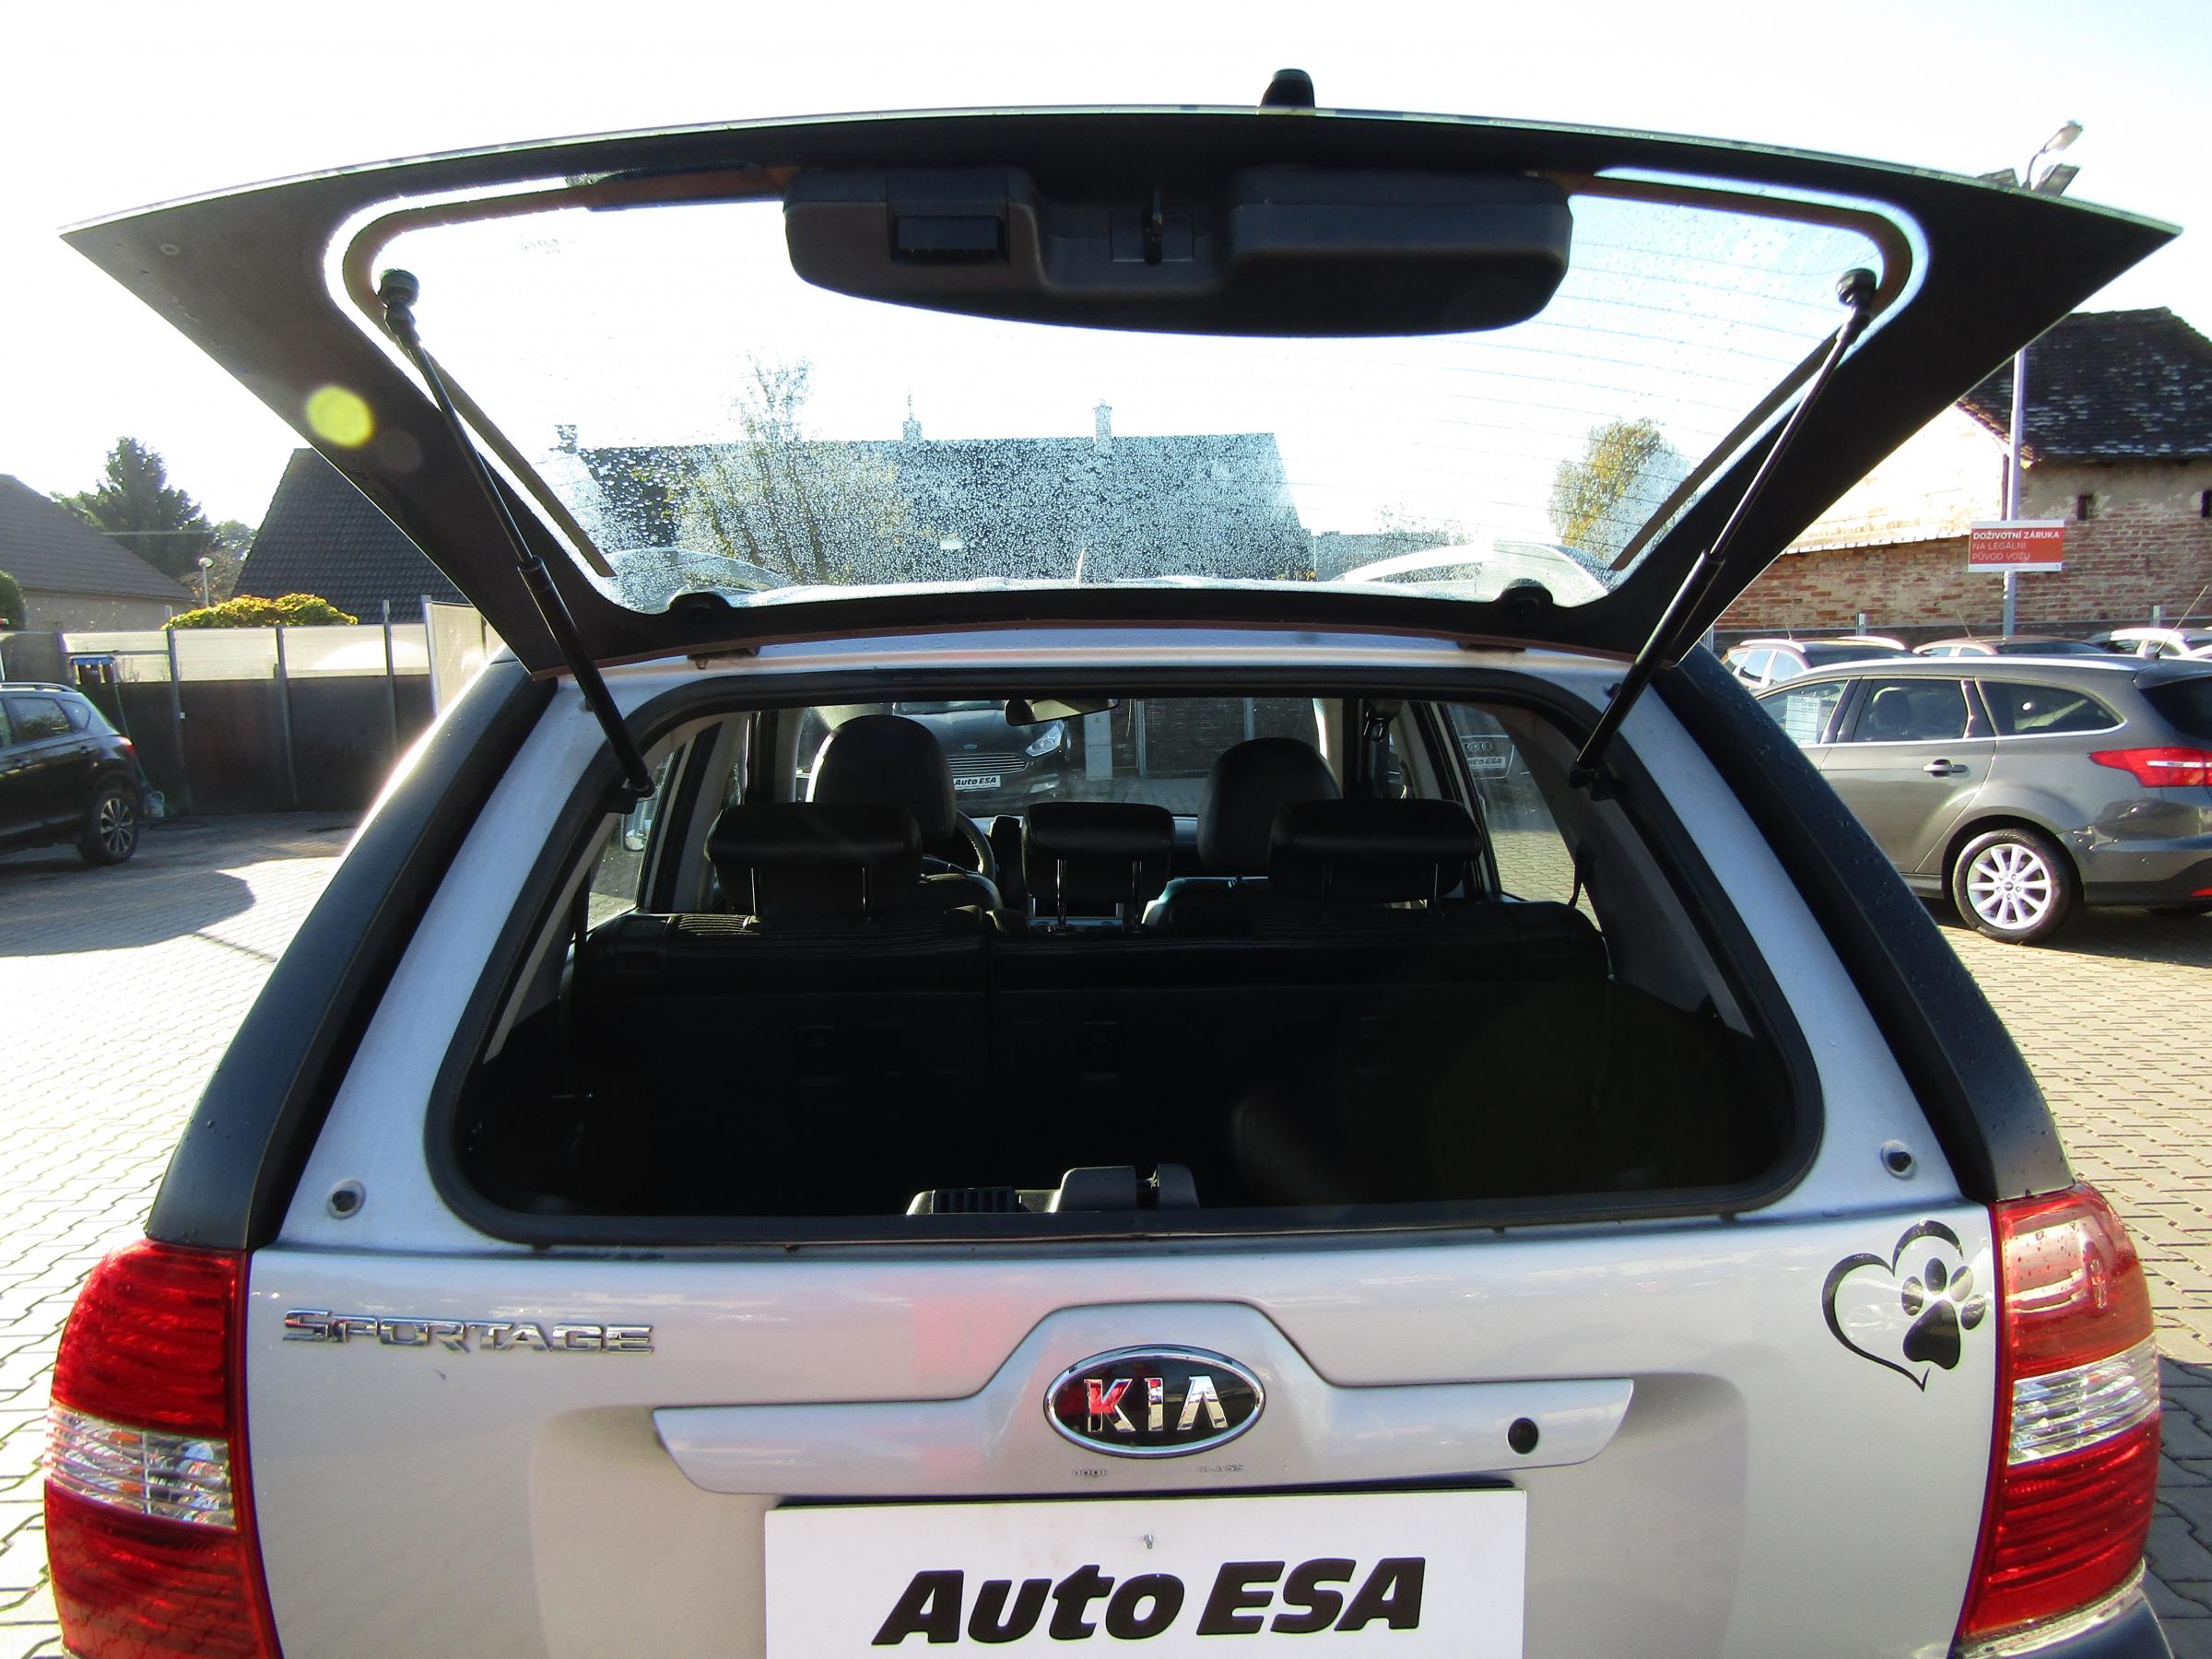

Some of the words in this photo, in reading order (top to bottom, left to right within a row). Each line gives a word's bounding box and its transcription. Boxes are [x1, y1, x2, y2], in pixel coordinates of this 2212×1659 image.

[1972, 530, 2022, 540] DOŽIVOTNÍ
[2023, 529, 2060, 539] ZÁRUKA
[1972, 542, 1986, 550] NA
[1083, 1375, 1229, 1433] KIA
[871, 1564, 1185, 1646] Auto
[1196, 1557, 1426, 1636] ESA
